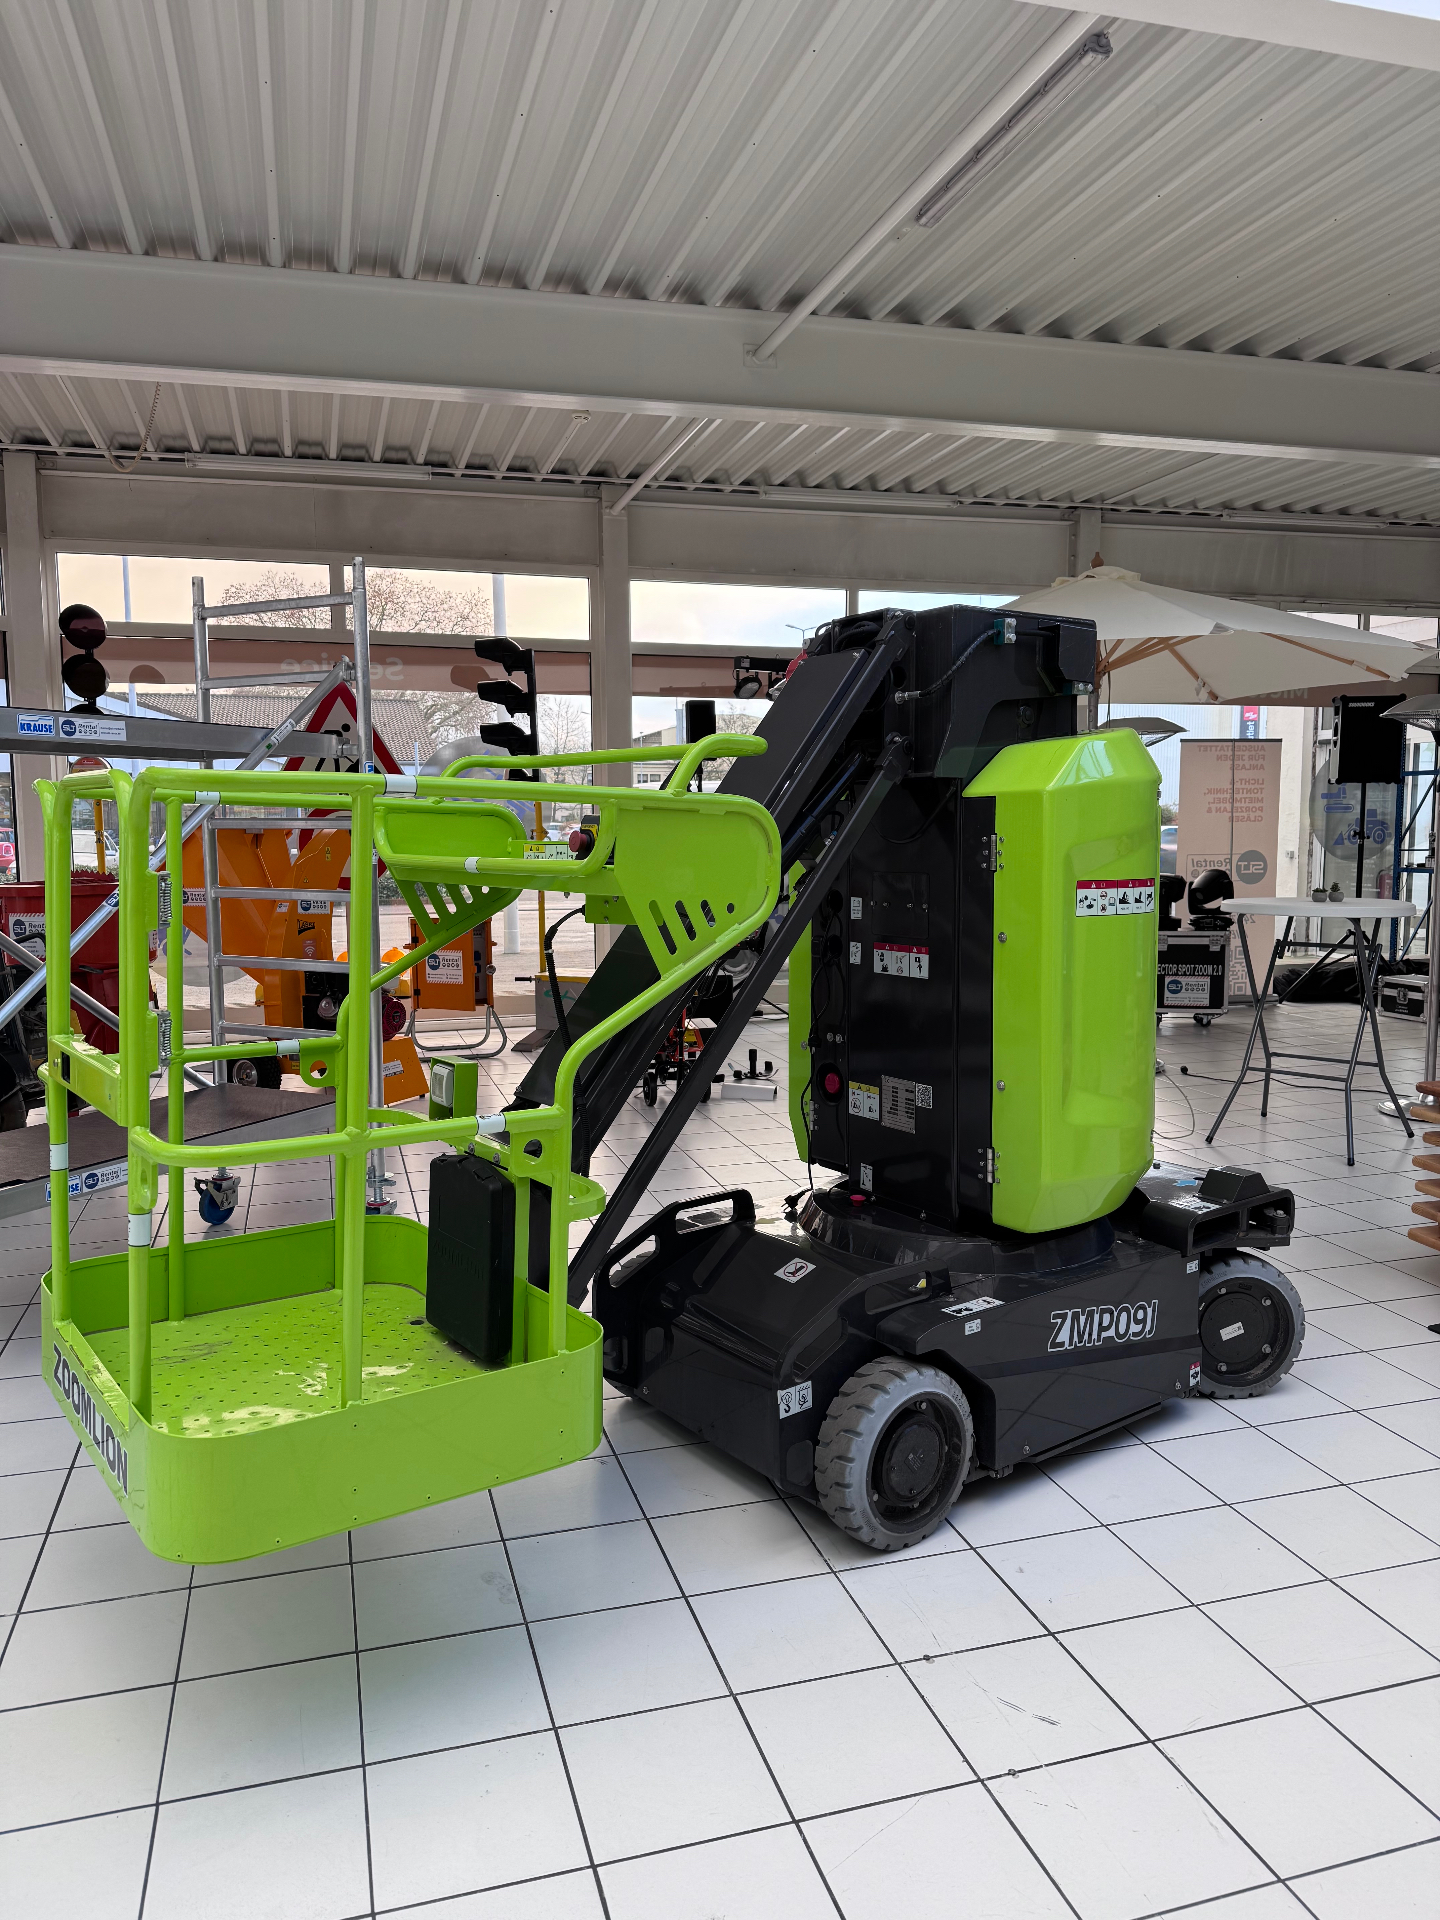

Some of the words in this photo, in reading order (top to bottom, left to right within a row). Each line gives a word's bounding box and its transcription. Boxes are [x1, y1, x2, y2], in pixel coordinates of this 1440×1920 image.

[20, 722, 53, 733] KRAUSE
[62, 724, 76, 733] SLT
[13, 925, 26, 933] SLT
[1178, 964, 1194, 975] SPOT
[1194, 964, 1213, 975] ZOOM
[1213, 965, 1223, 975] 2.0
[100, 1168, 119, 1178] Rental
[1048, 1300, 1158, 1352] ZMP09J
[53, 1340, 128, 1498] ZOOMLION
